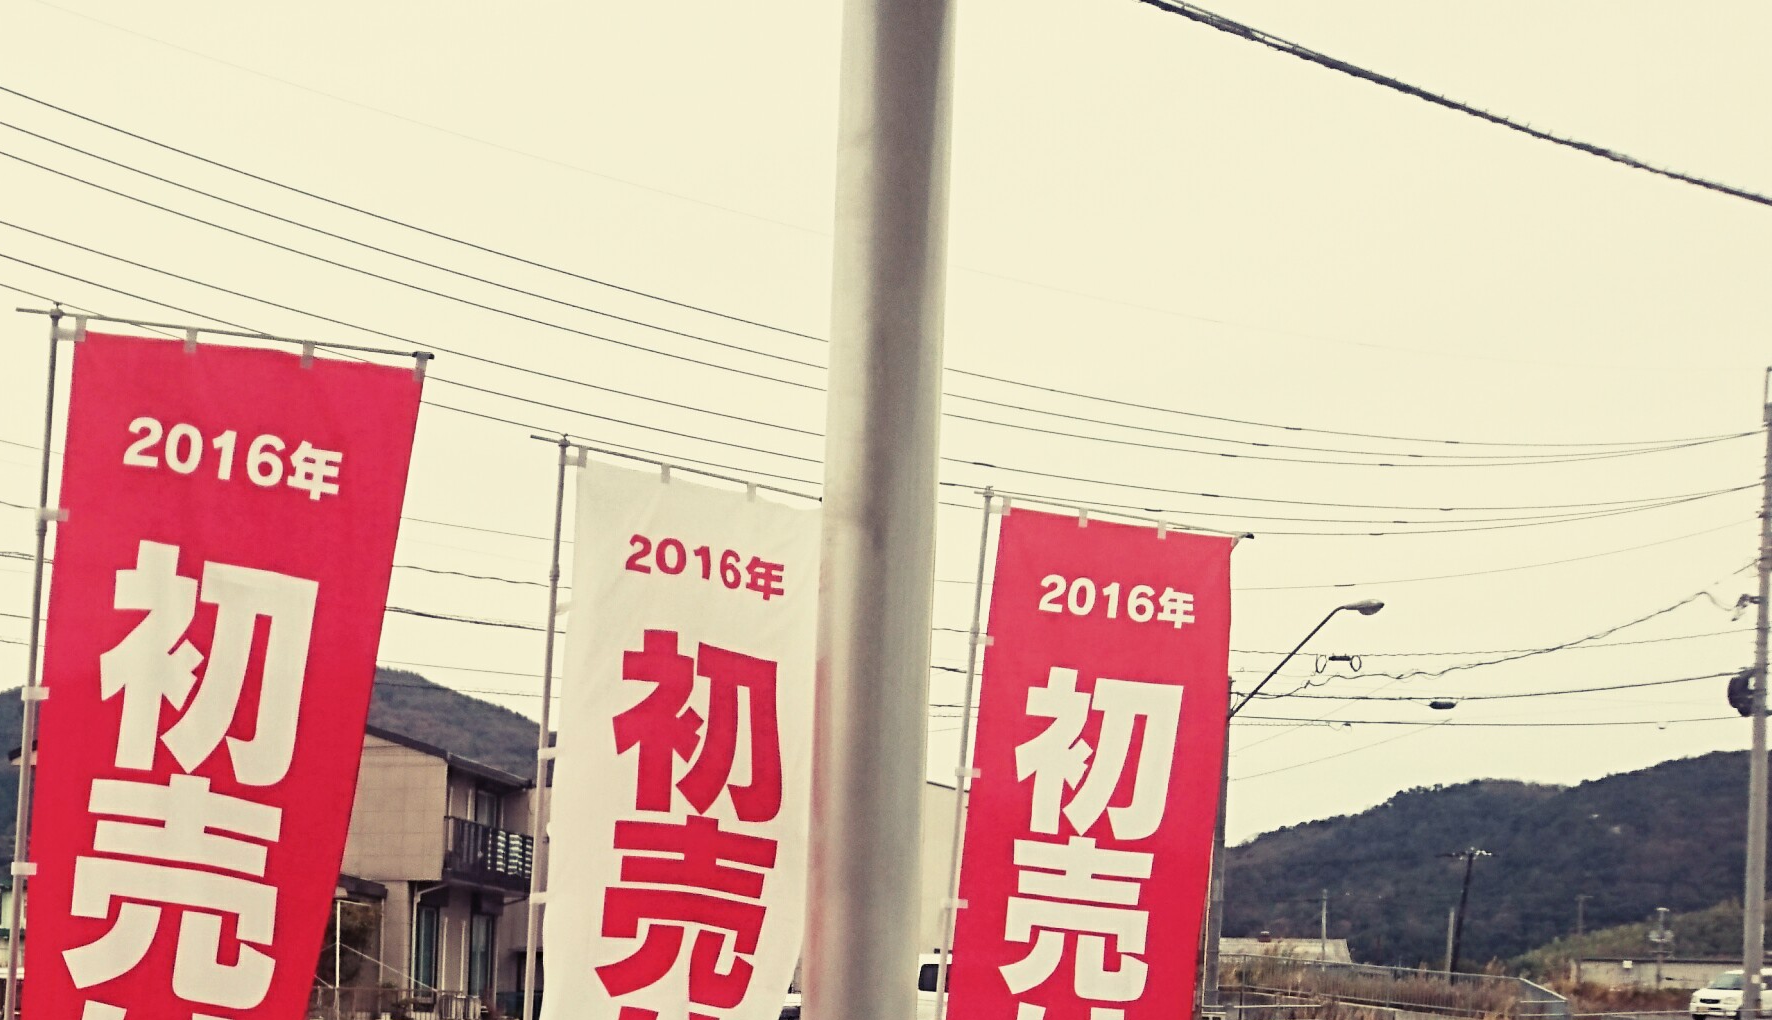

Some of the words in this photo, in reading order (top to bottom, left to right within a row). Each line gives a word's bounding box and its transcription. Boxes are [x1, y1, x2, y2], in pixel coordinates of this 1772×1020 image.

[122, 416, 343, 500] 2016年
[625, 534, 785, 600] 2016年
[1038, 574, 1195, 629] 2016年
